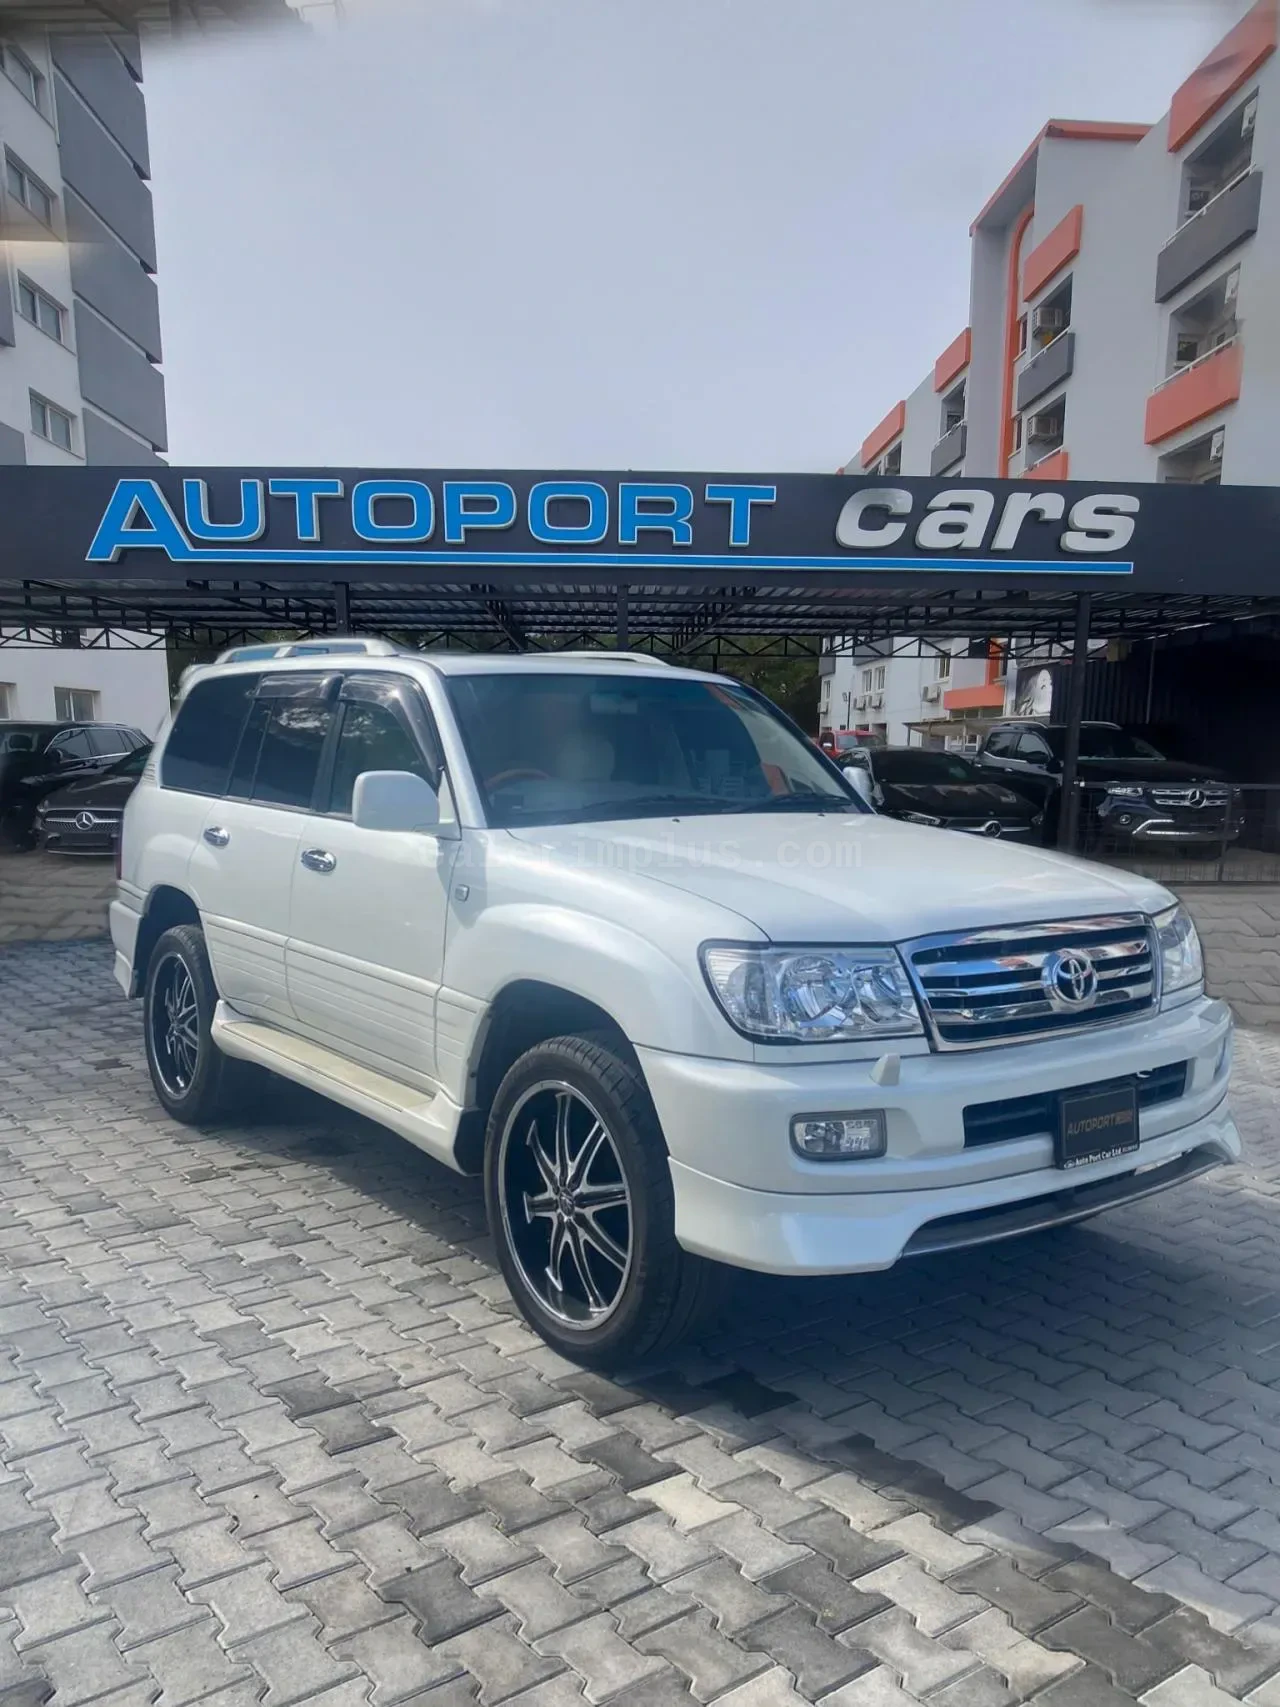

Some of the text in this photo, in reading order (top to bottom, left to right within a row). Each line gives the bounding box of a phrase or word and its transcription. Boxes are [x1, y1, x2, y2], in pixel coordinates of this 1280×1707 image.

[85, 478, 1142, 563] AUTOPORT cars
[1067, 1114, 1115, 1136] AUTOPORT
[1089, 1152, 1101, 1163] Port
